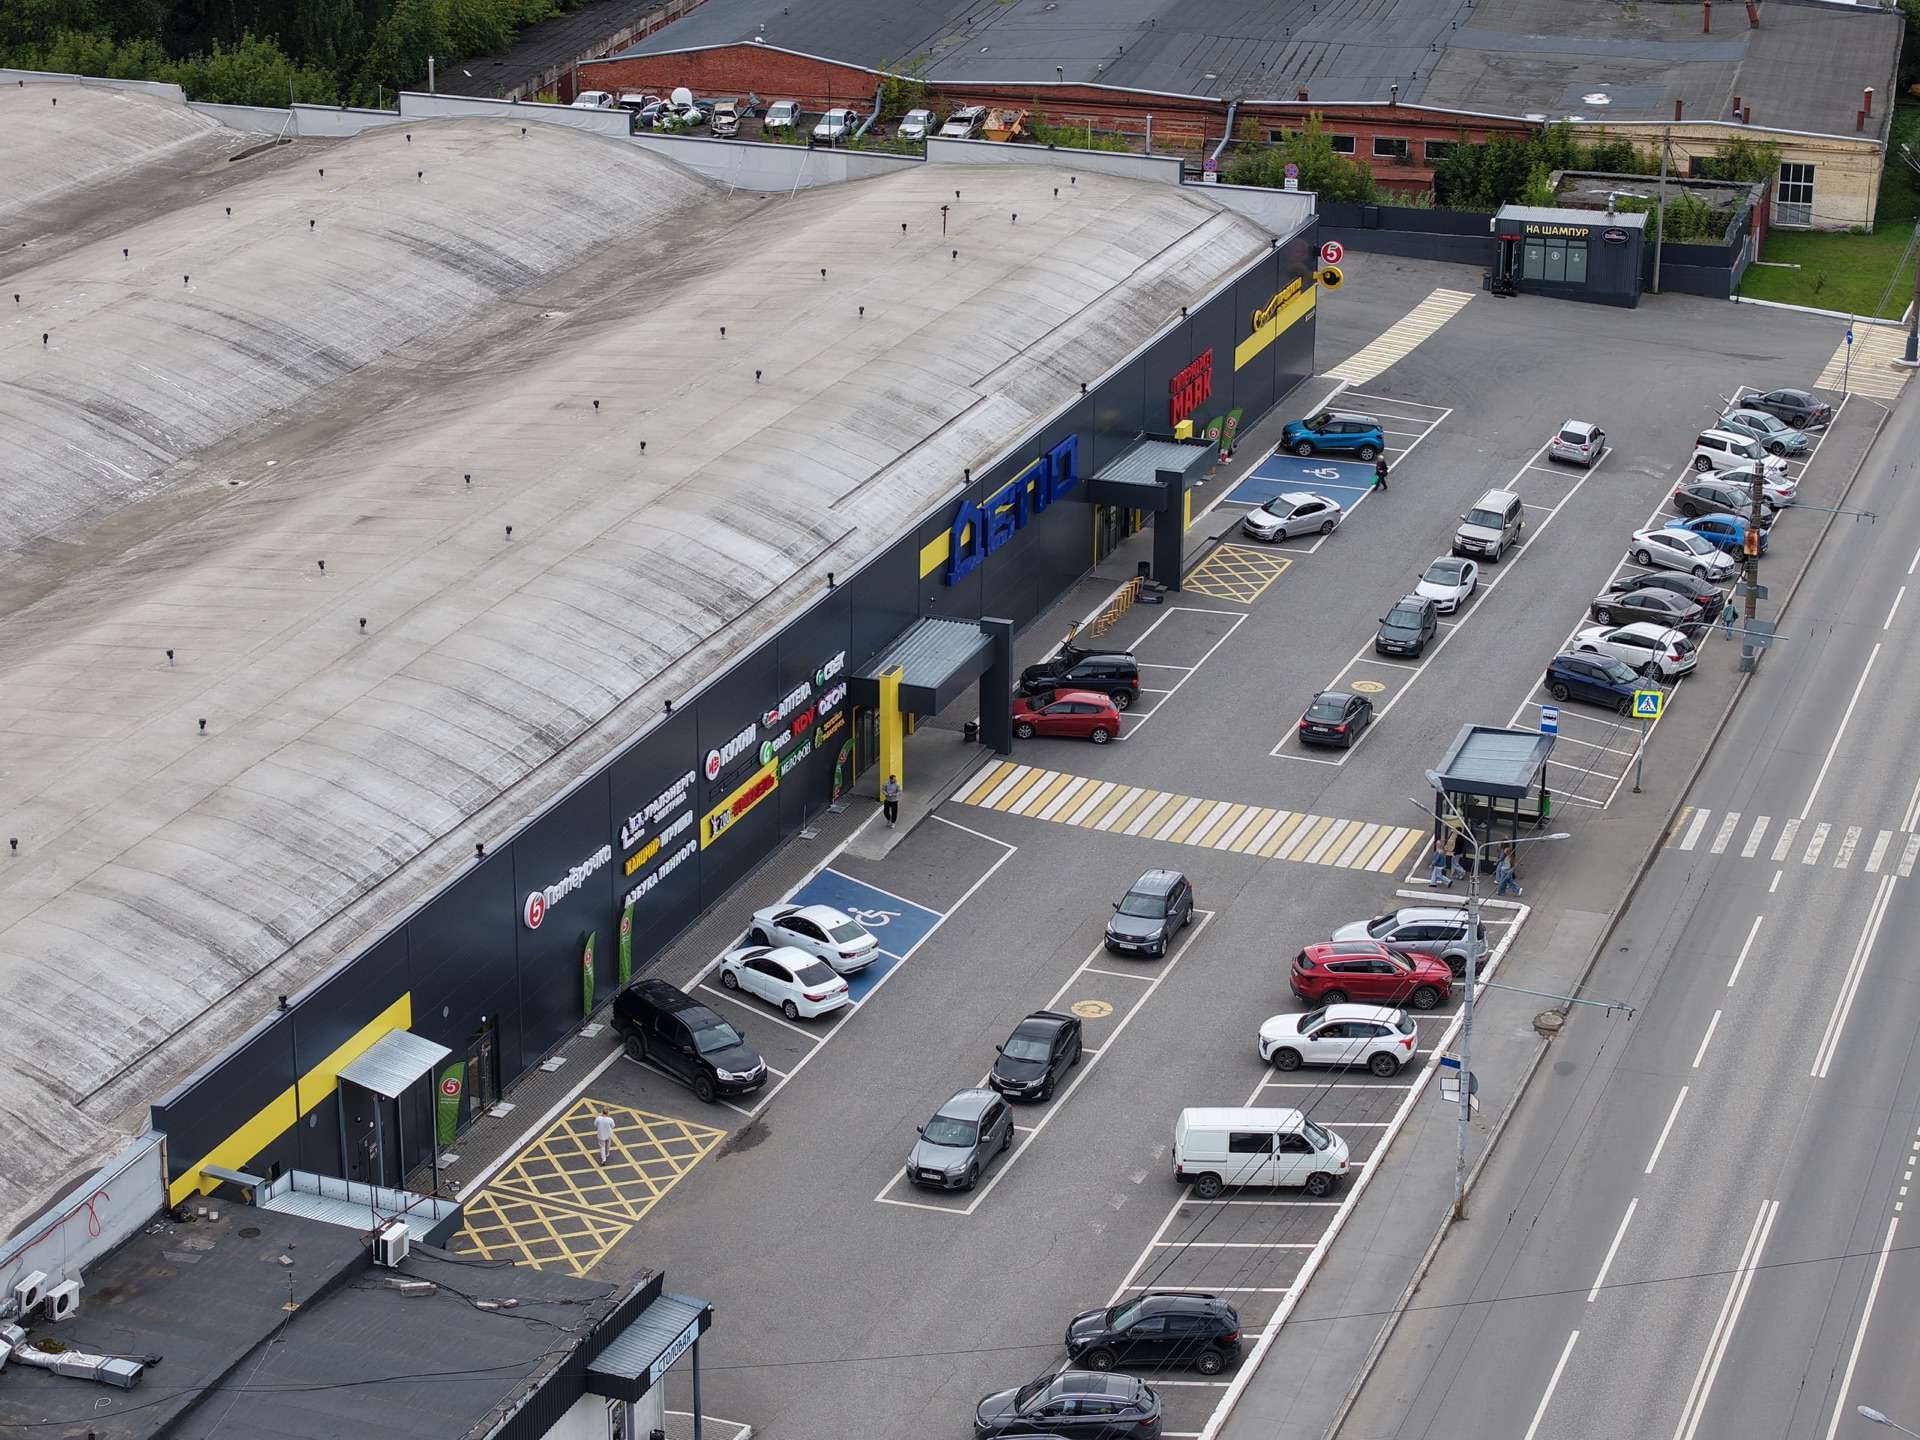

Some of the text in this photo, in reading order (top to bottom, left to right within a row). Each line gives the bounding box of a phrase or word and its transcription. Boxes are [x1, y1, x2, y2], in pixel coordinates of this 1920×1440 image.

[1526, 224, 1589, 238] НА ШАМПУР
[1326, 246, 1338, 261] 5
[1170, 367, 1213, 426] МАЯК
[945, 434, 1078, 587] ДЕПО
[778, 681, 812, 721] АПТЕКА
[818, 682, 847, 716] OZON
[720, 723, 757, 767] КУХНИ
[643, 770, 696, 822] УРАЛЭНЕРГО
[652, 791, 687, 824] ЭЛЕКТРИКА
[625, 836, 660, 877] КАНЦМИР
[659, 810, 693, 848] ИГРУШКИ
[543, 844, 612, 910] Пятёрочка
[625, 839, 697, 909] АЗБУКА ПЕННОГО
[657, 1329, 691, 1373] СТОЛОВАЯ
